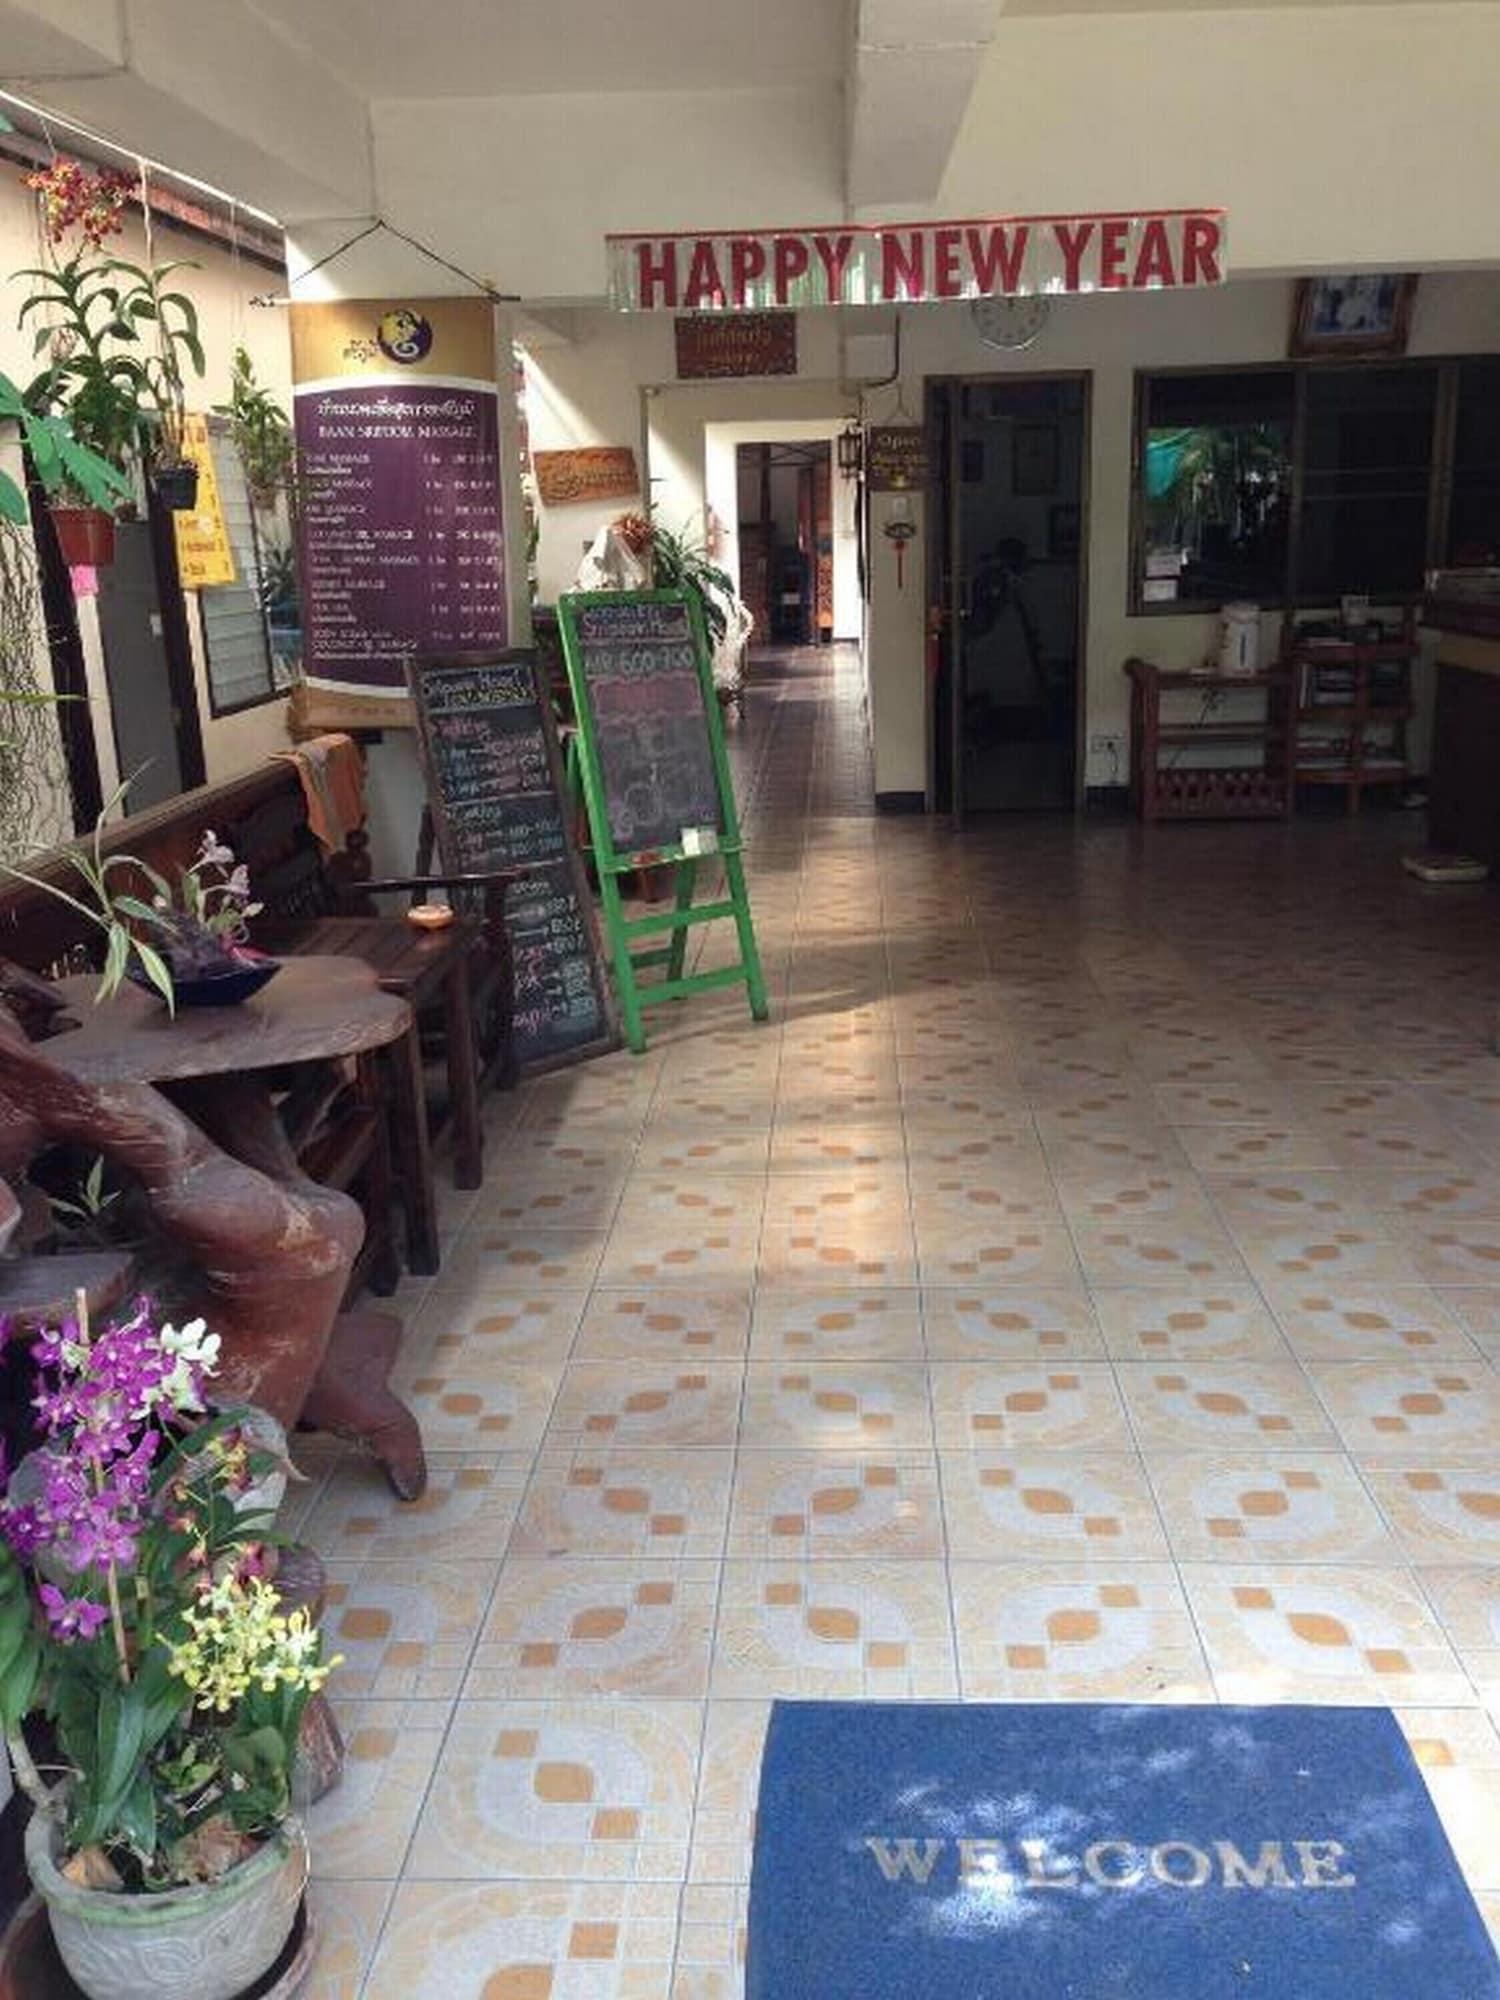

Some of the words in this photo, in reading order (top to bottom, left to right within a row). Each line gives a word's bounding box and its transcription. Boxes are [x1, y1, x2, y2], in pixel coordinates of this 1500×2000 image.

[636, 234, 853, 310] HAPPY
[880, 224, 1030, 301] NEW
[1053, 217, 1222, 292] YEAR
[864, 1837, 1357, 1889] WELCOME
